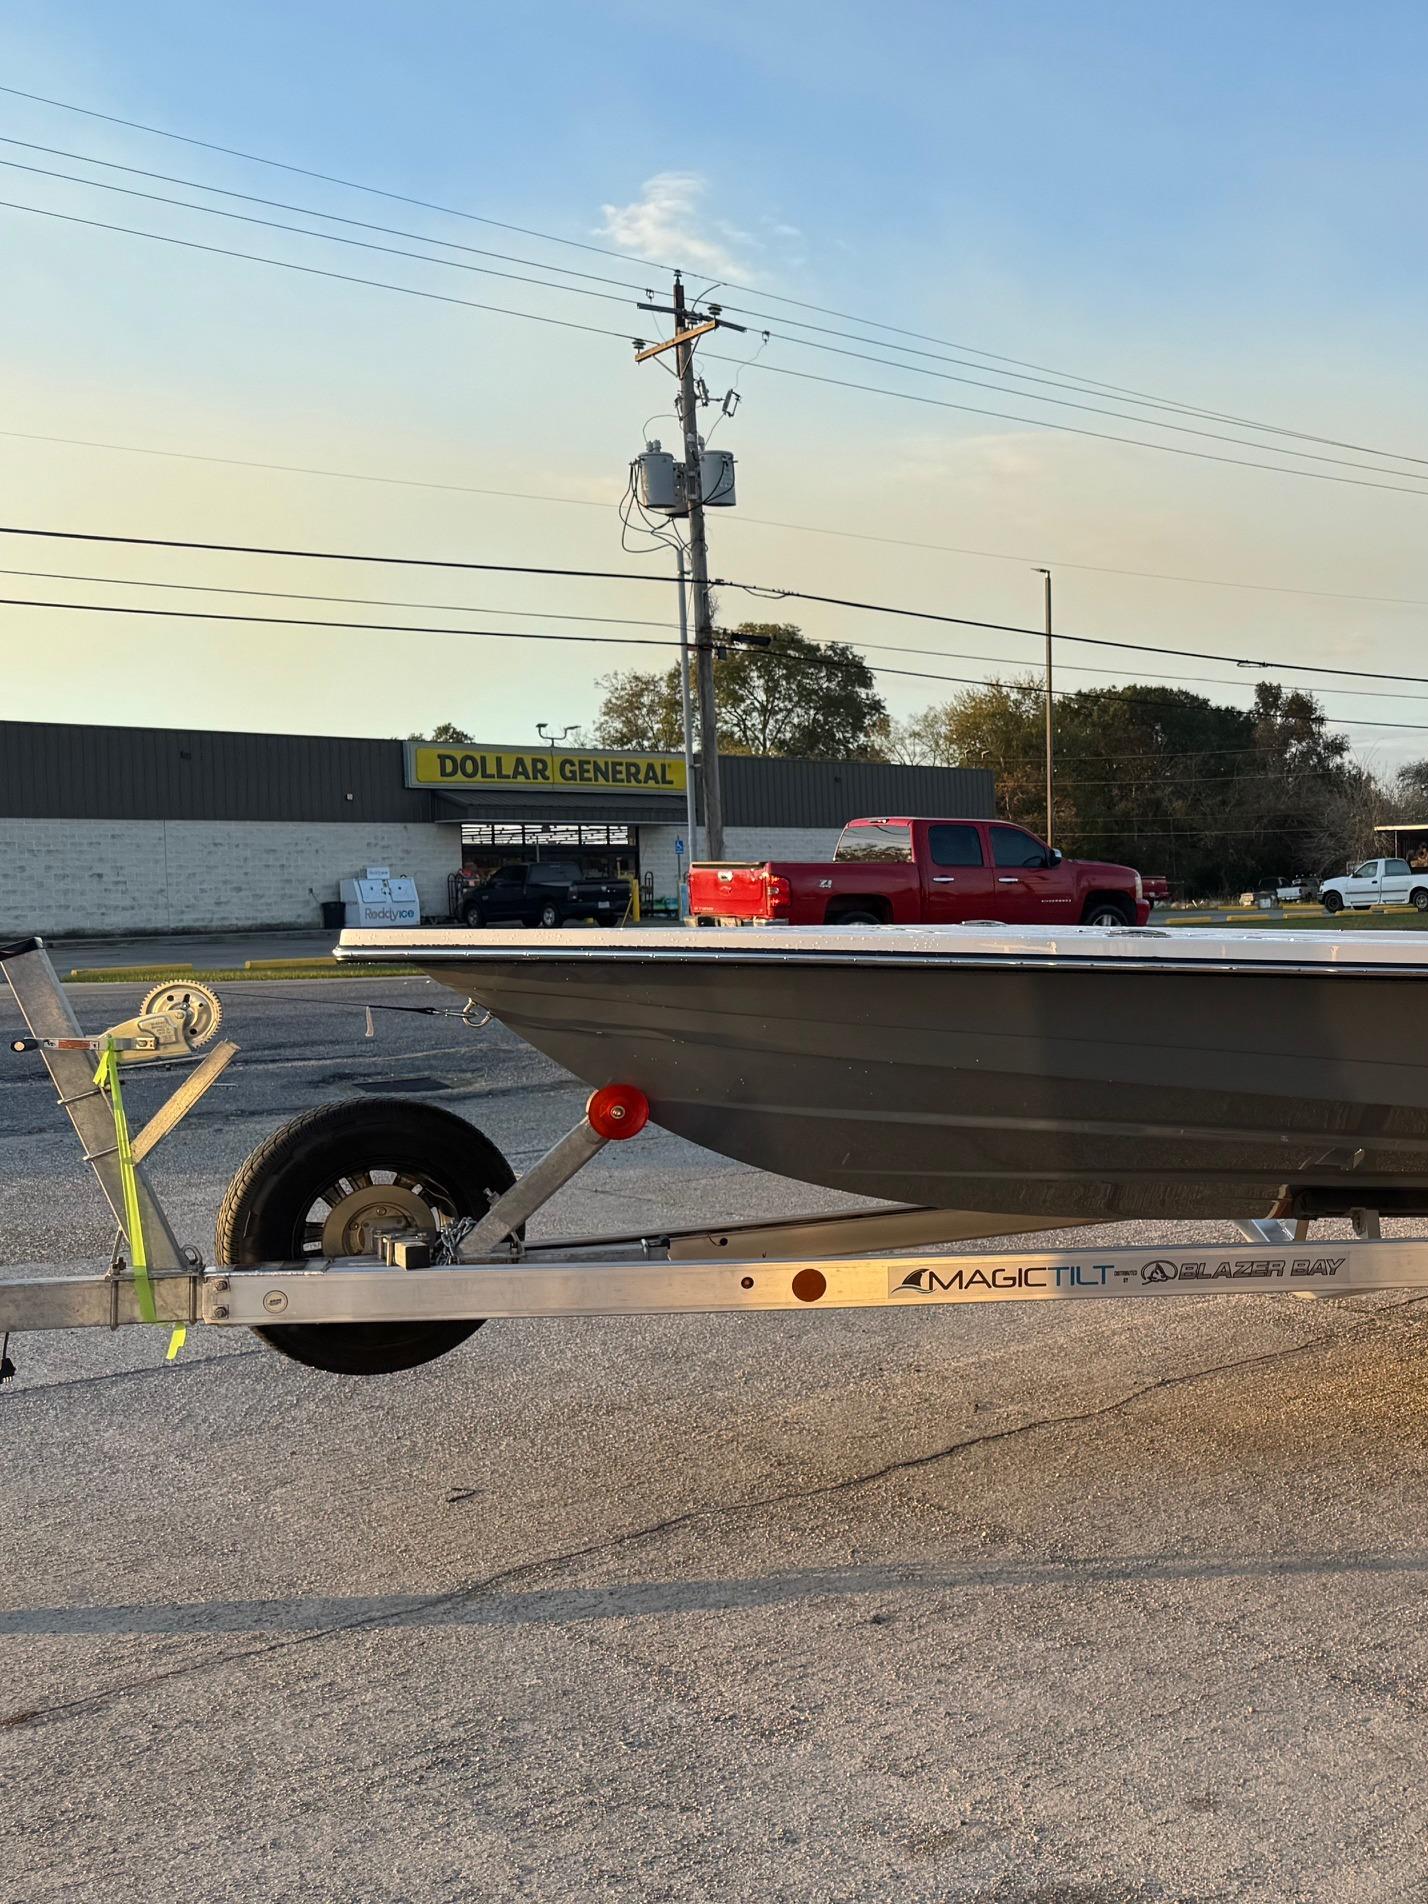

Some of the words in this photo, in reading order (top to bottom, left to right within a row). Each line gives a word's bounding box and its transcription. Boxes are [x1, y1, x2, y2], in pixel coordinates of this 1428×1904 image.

[437, 753, 550, 781] DOLLAR
[559, 758, 674, 785] GENERAL
[1178, 1260, 1286, 1281] BLAZER
[1290, 1258, 1347, 1277] BAY
